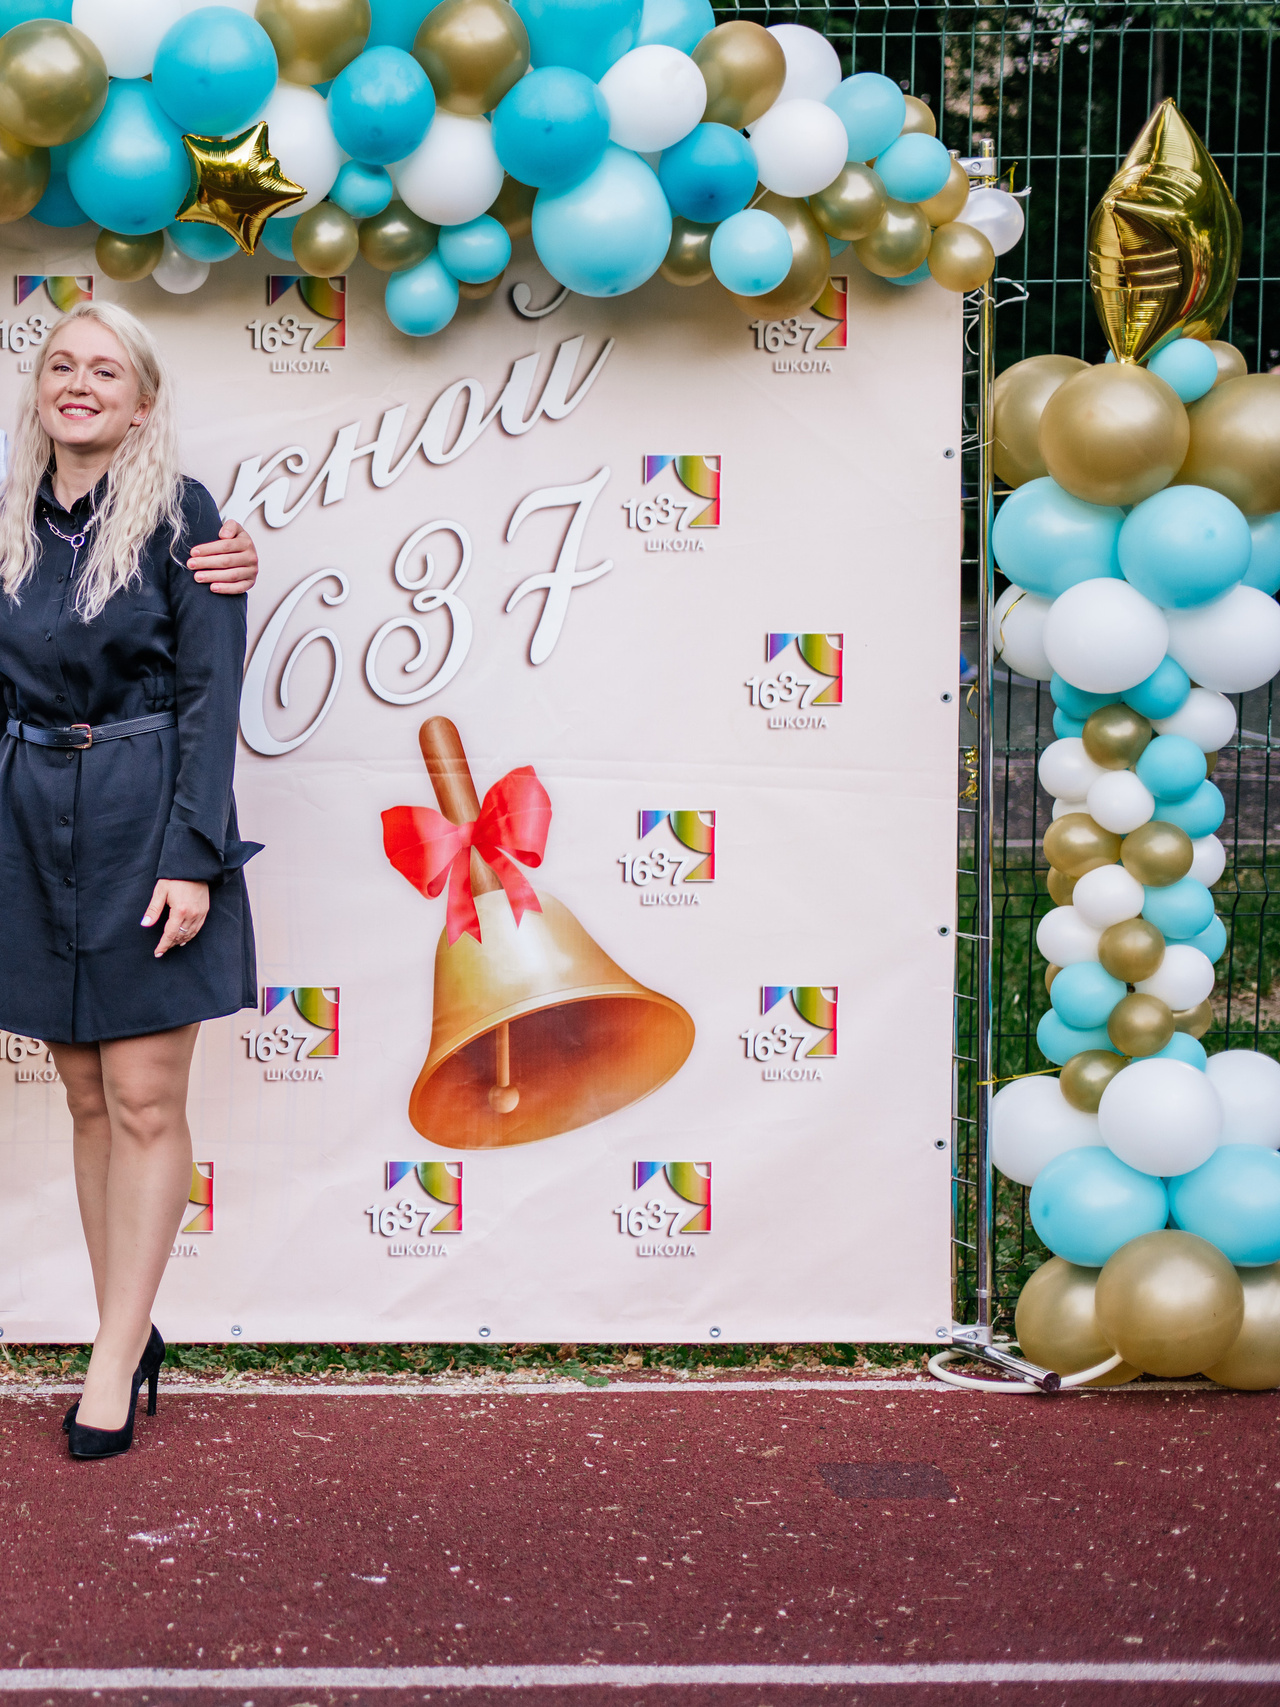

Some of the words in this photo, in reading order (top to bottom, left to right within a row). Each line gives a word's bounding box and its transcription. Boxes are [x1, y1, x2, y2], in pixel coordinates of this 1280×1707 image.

[248, 314, 319, 352] 1637
[751, 315, 821, 352] 1637
[272, 360, 332, 374] ШКОЛА
[774, 360, 832, 373] ШКОЛА
[623, 493, 694, 531] 1637
[647, 539, 705, 552] ШКОЛА
[746, 671, 817, 709] 1637
[769, 716, 829, 730] ШКОЛА
[619, 848, 689, 885] 1637
[642, 893, 700, 906] ШКОЛА
[243, 1024, 313, 1061] 1637
[740, 1023, 811, 1061] 1637
[18, 1069, 60, 1082] ШКО
[266, 1068, 324, 1081] ШКОЛА
[764, 1068, 824, 1082] ШКОЛА
[366, 1199, 437, 1237] 1637
[615, 1199, 685, 1236] 1637
[390, 1244, 448, 1257] ШКОЛА
[638, 1243, 698, 1257] ШКОЛА
